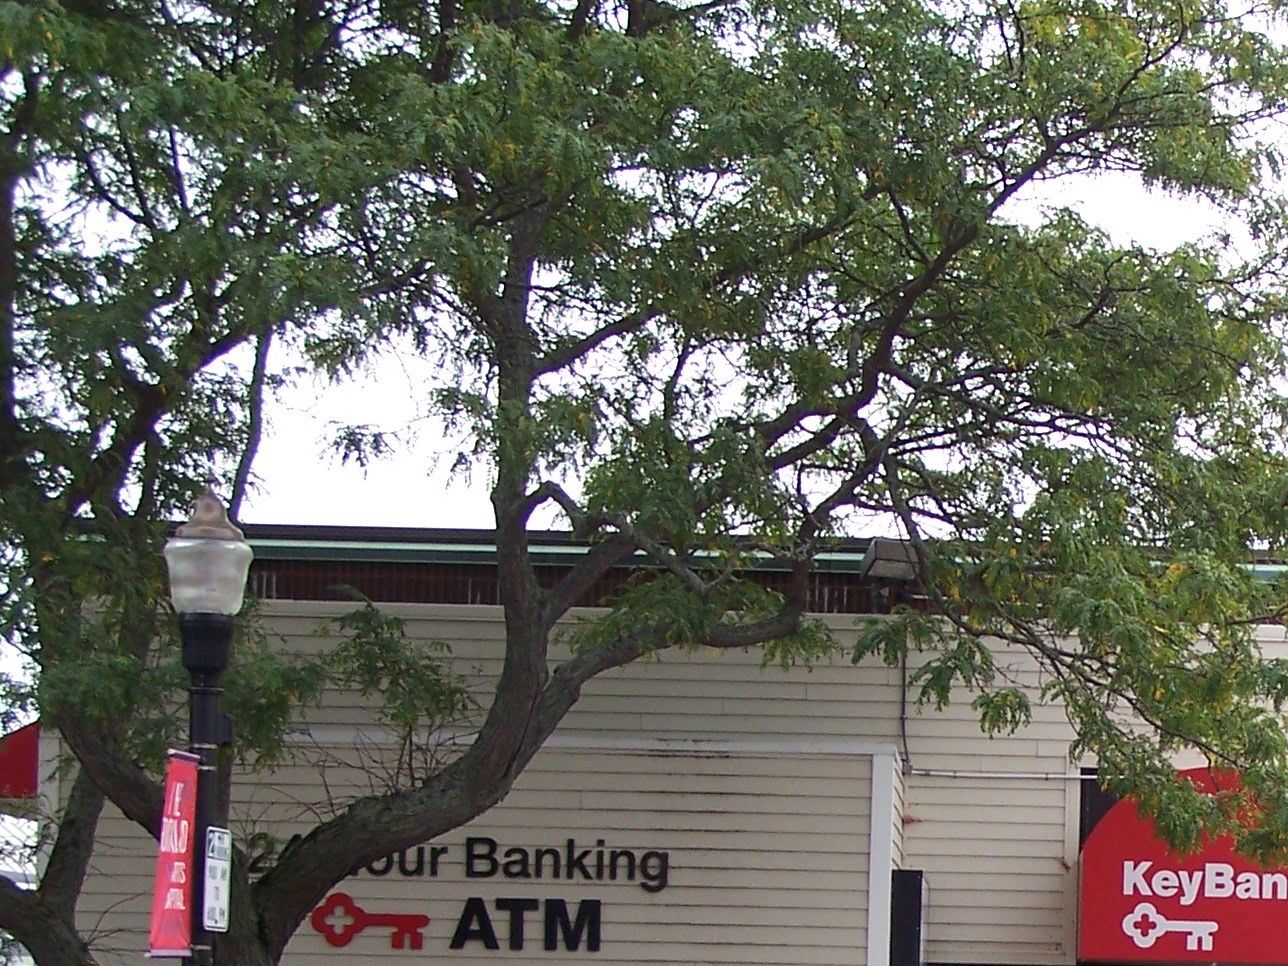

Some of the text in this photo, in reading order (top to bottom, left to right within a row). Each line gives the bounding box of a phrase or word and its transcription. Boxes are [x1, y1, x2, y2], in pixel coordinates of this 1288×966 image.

[349, 845, 449, 877] our
[466, 836, 669, 893] Banking
[449, 897, 602, 952] ATM
